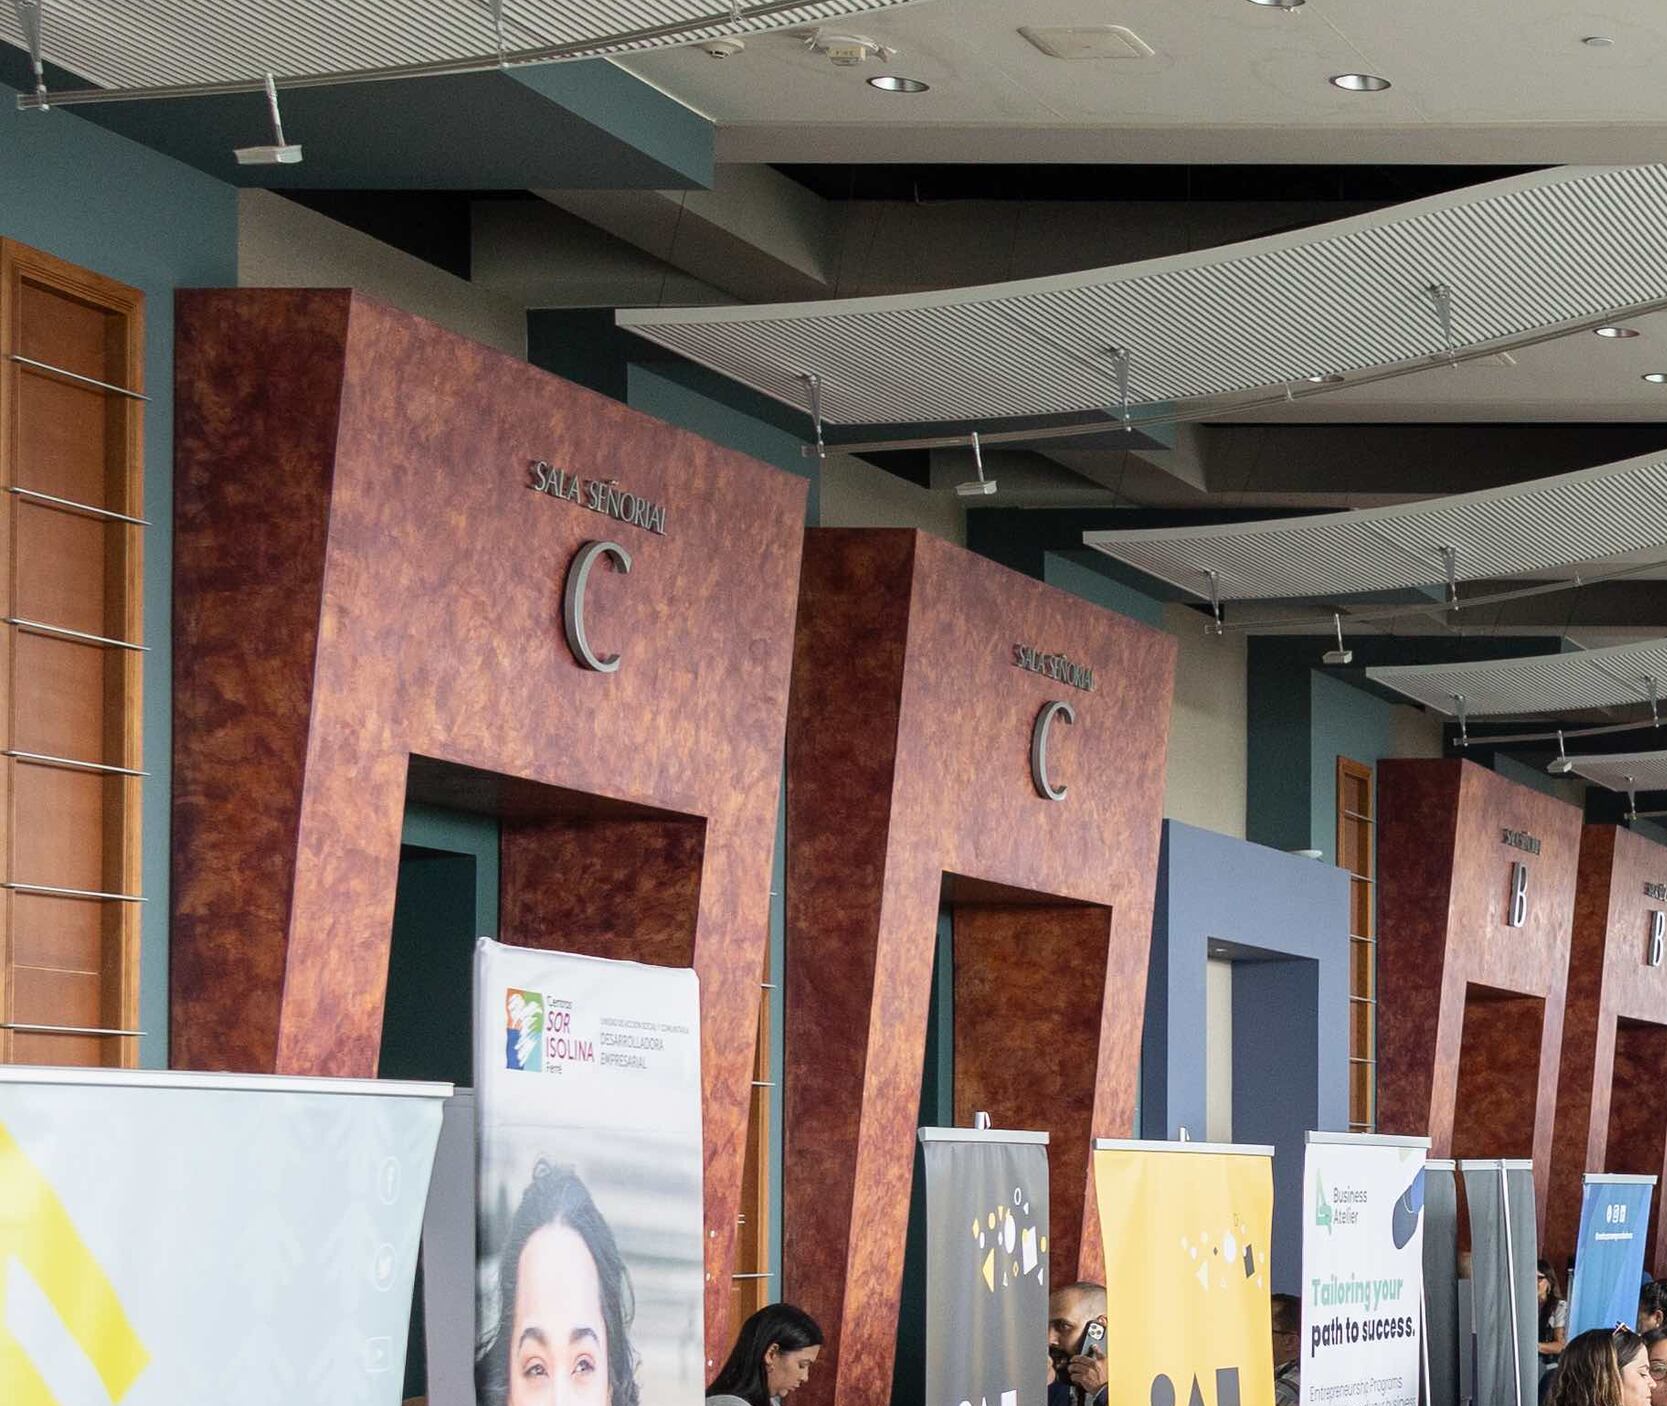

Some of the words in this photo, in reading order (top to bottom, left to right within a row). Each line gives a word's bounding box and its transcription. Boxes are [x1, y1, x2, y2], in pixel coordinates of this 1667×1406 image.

[534, 461, 581, 504] SALA
[587, 480, 667, 537] SEÑORIAL
[563, 540, 632, 674] C
[1016, 643, 1046, 675] SALA
[1031, 700, 1075, 801] C
[1508, 861, 1528, 929] B
[1648, 910, 1666, 967] B
[546, 1010, 571, 1034] SOR
[546, 1036, 595, 1062] ISOLINA
[600, 1031, 665, 1051] DESARROLLADORA
[600, 1051, 648, 1069] EMPRESARIAL
[1333, 1186, 1368, 1204] Business
[1333, 1209, 1359, 1225] Atelier
[1312, 1272, 1370, 1313] Tailoring
[1373, 1278, 1404, 1312] your
[1311, 1316, 1343, 1359] path
[1346, 1317, 1360, 1344] to
[1362, 1315, 1416, 1342] success.
